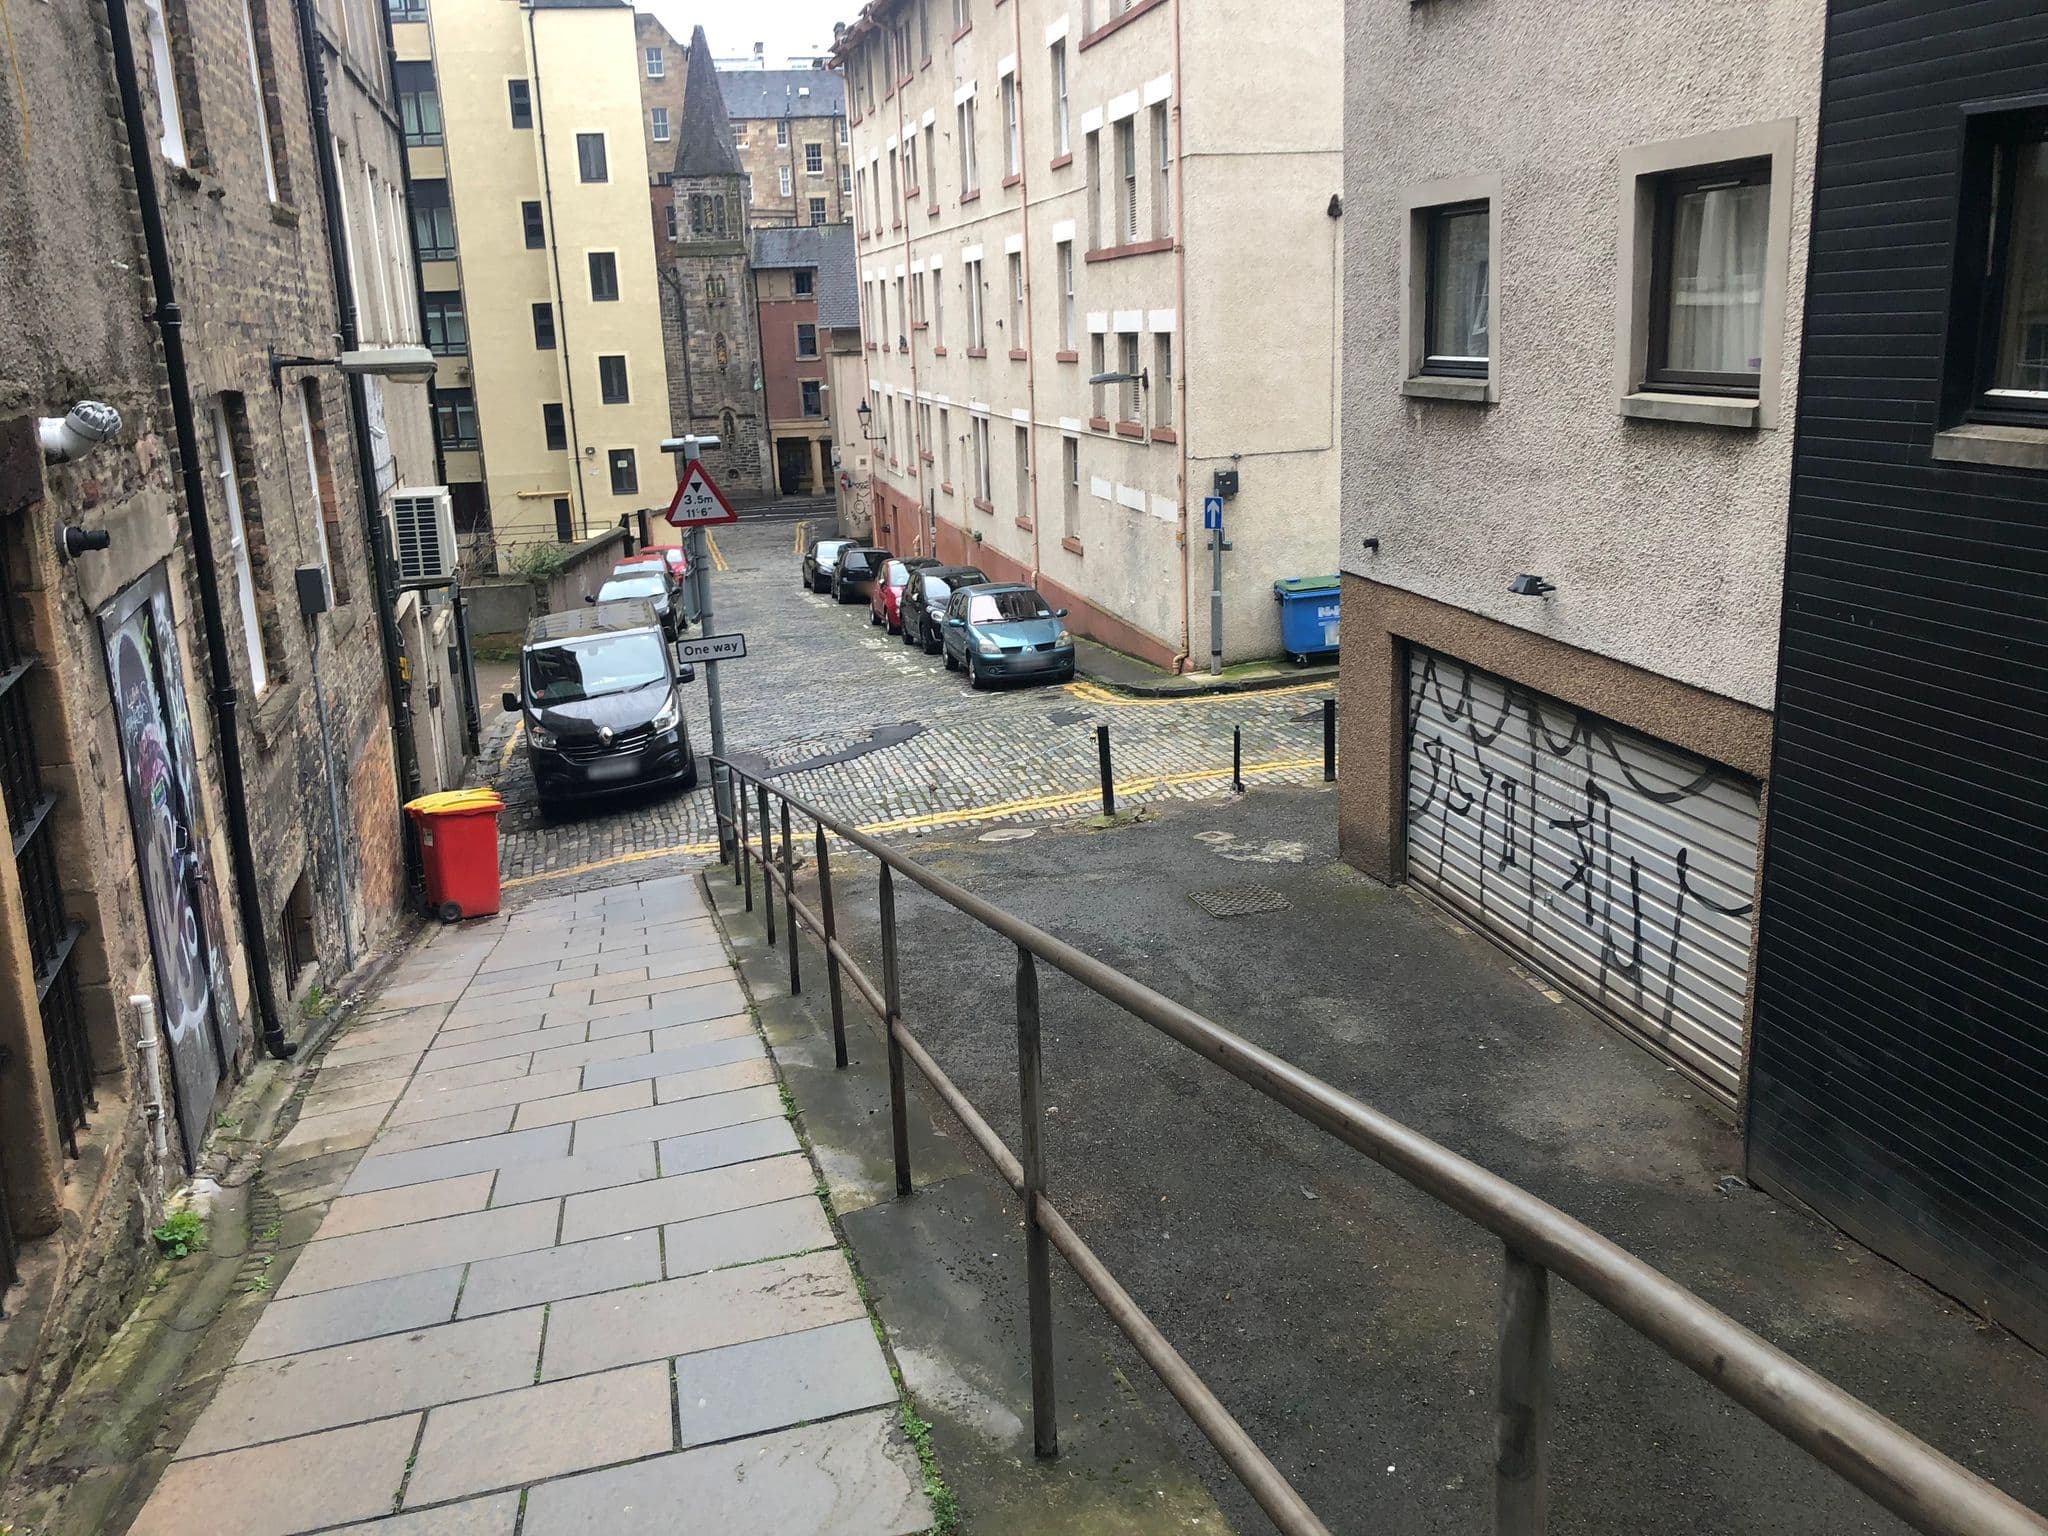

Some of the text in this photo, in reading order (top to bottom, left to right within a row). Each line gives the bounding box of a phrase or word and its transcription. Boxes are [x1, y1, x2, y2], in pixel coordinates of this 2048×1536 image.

[684, 495, 713, 505] 3.5m
[684, 643, 738, 656] One way
